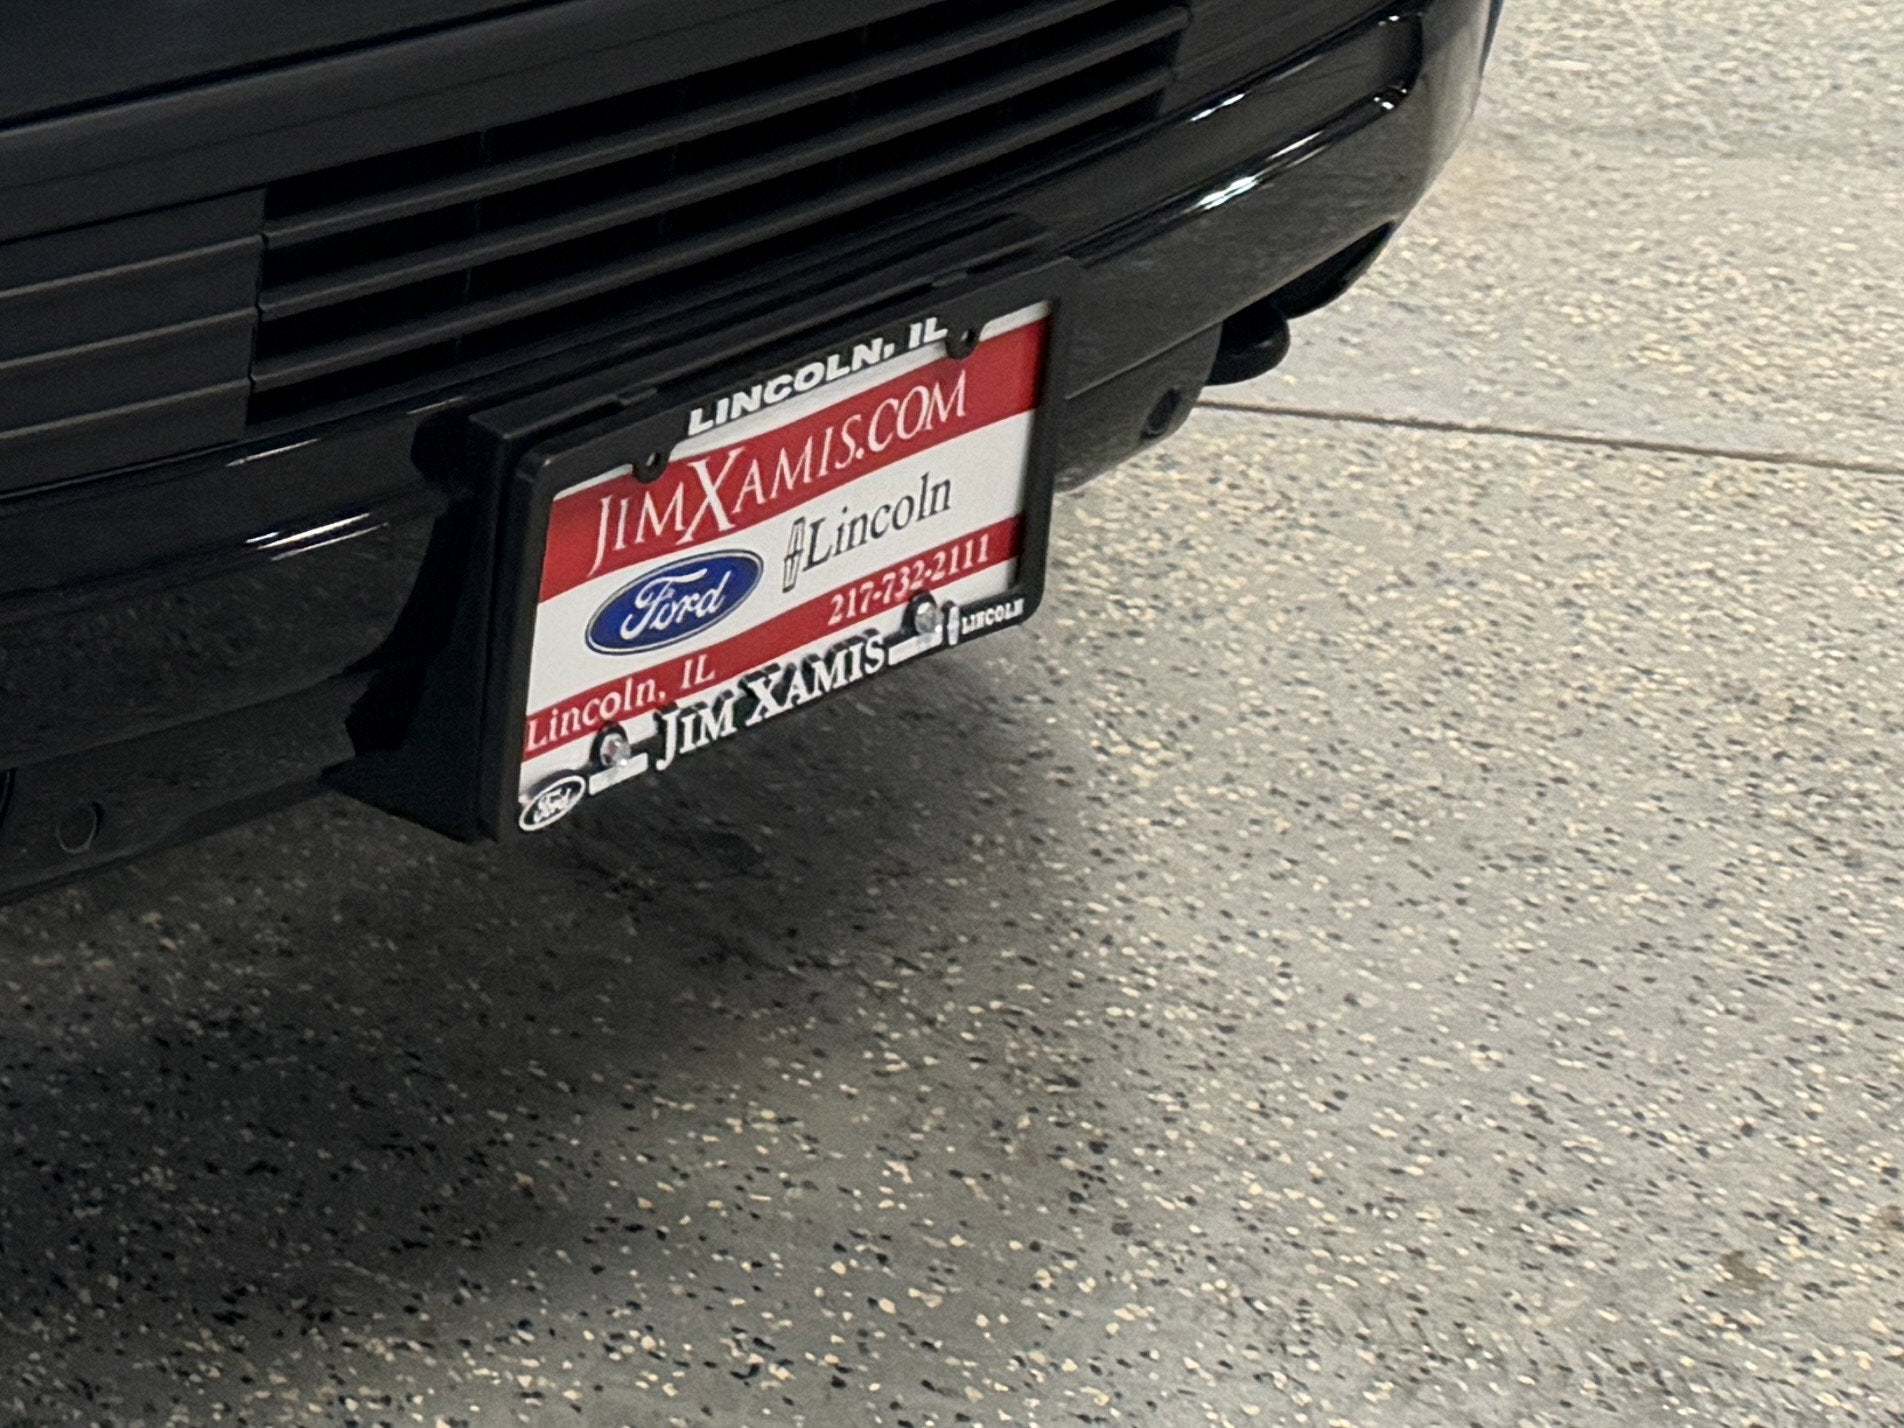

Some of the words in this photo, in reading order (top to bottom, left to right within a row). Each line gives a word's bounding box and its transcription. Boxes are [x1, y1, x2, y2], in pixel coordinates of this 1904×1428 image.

[908, 316, 949, 350] IL
[588, 368, 967, 577] JIMXAMIS.COM
[801, 472, 953, 573] Lincoln
[619, 566, 730, 641] Ford
[827, 532, 991, 627] 217-732-2111
[527, 677, 667, 751] Lincoln,
[680, 654, 717, 691] IL
[655, 700, 737, 772] JIM
[745, 634, 886, 728] XAMIS
